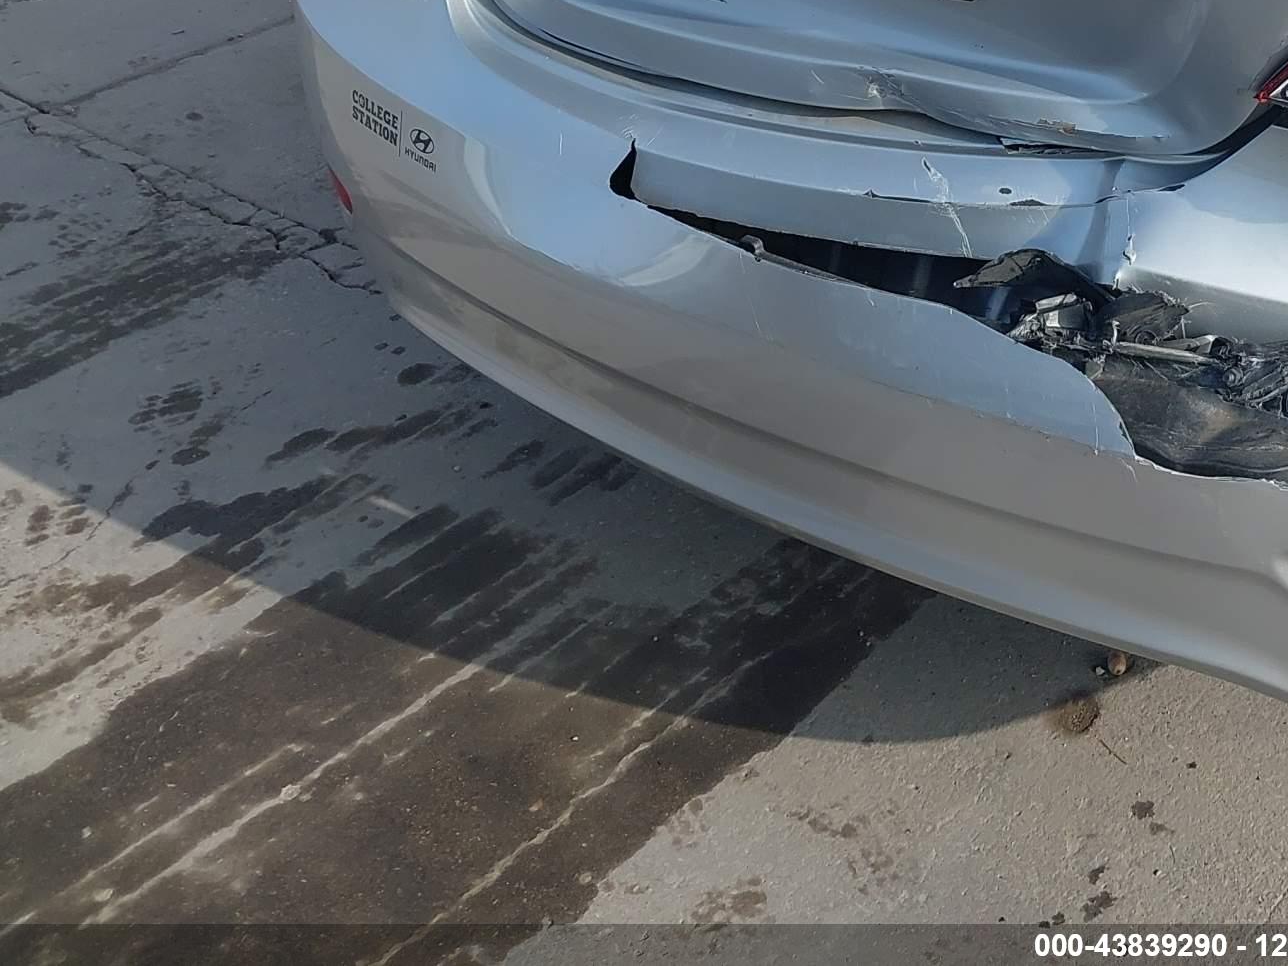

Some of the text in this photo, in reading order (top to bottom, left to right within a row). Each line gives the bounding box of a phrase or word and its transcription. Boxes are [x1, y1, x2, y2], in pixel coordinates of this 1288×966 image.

[352, 90, 398, 130] COLLEGE
[352, 106, 398, 146] STATION
[404, 147, 437, 173] HYUNDAI
